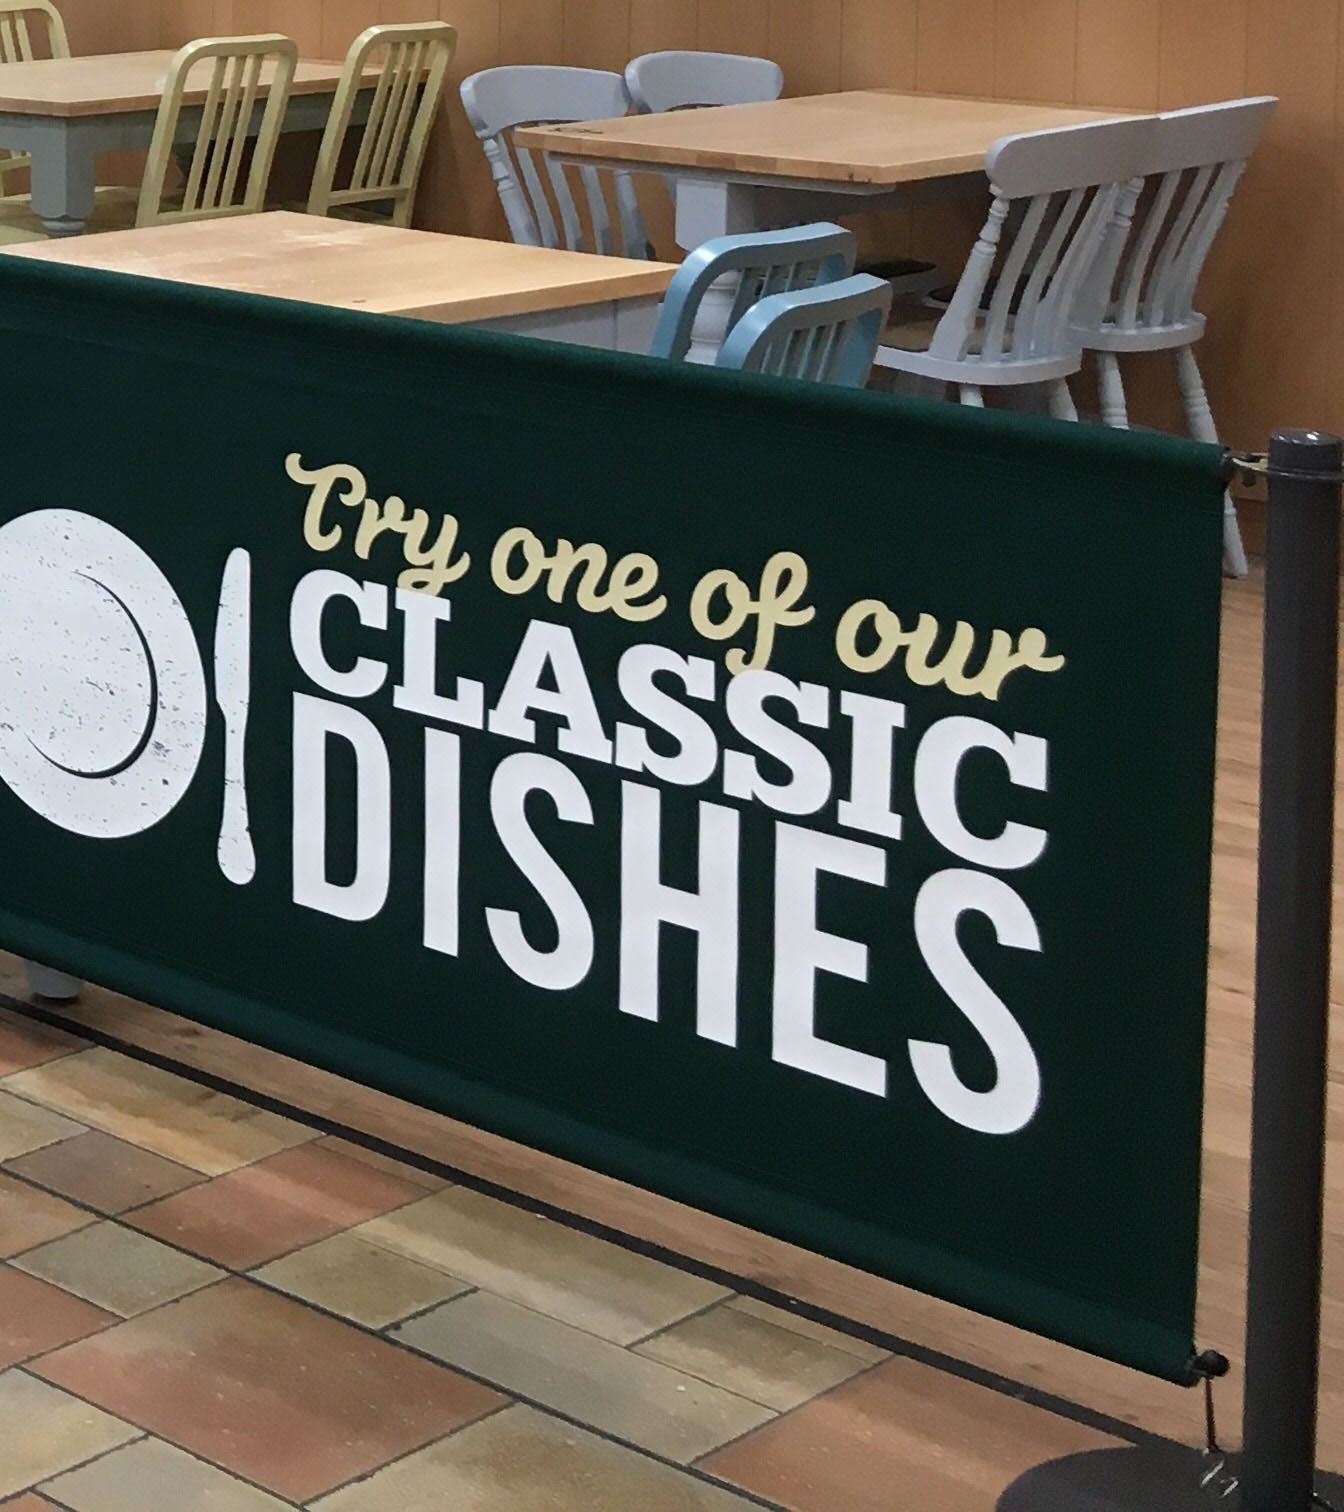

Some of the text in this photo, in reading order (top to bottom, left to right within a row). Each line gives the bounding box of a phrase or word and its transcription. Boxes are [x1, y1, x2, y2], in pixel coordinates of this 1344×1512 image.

[284, 453, 1064, 702] Try one of our
[289, 567, 1051, 871] CLASSIC
[291, 691, 1042, 1137] DISHES
